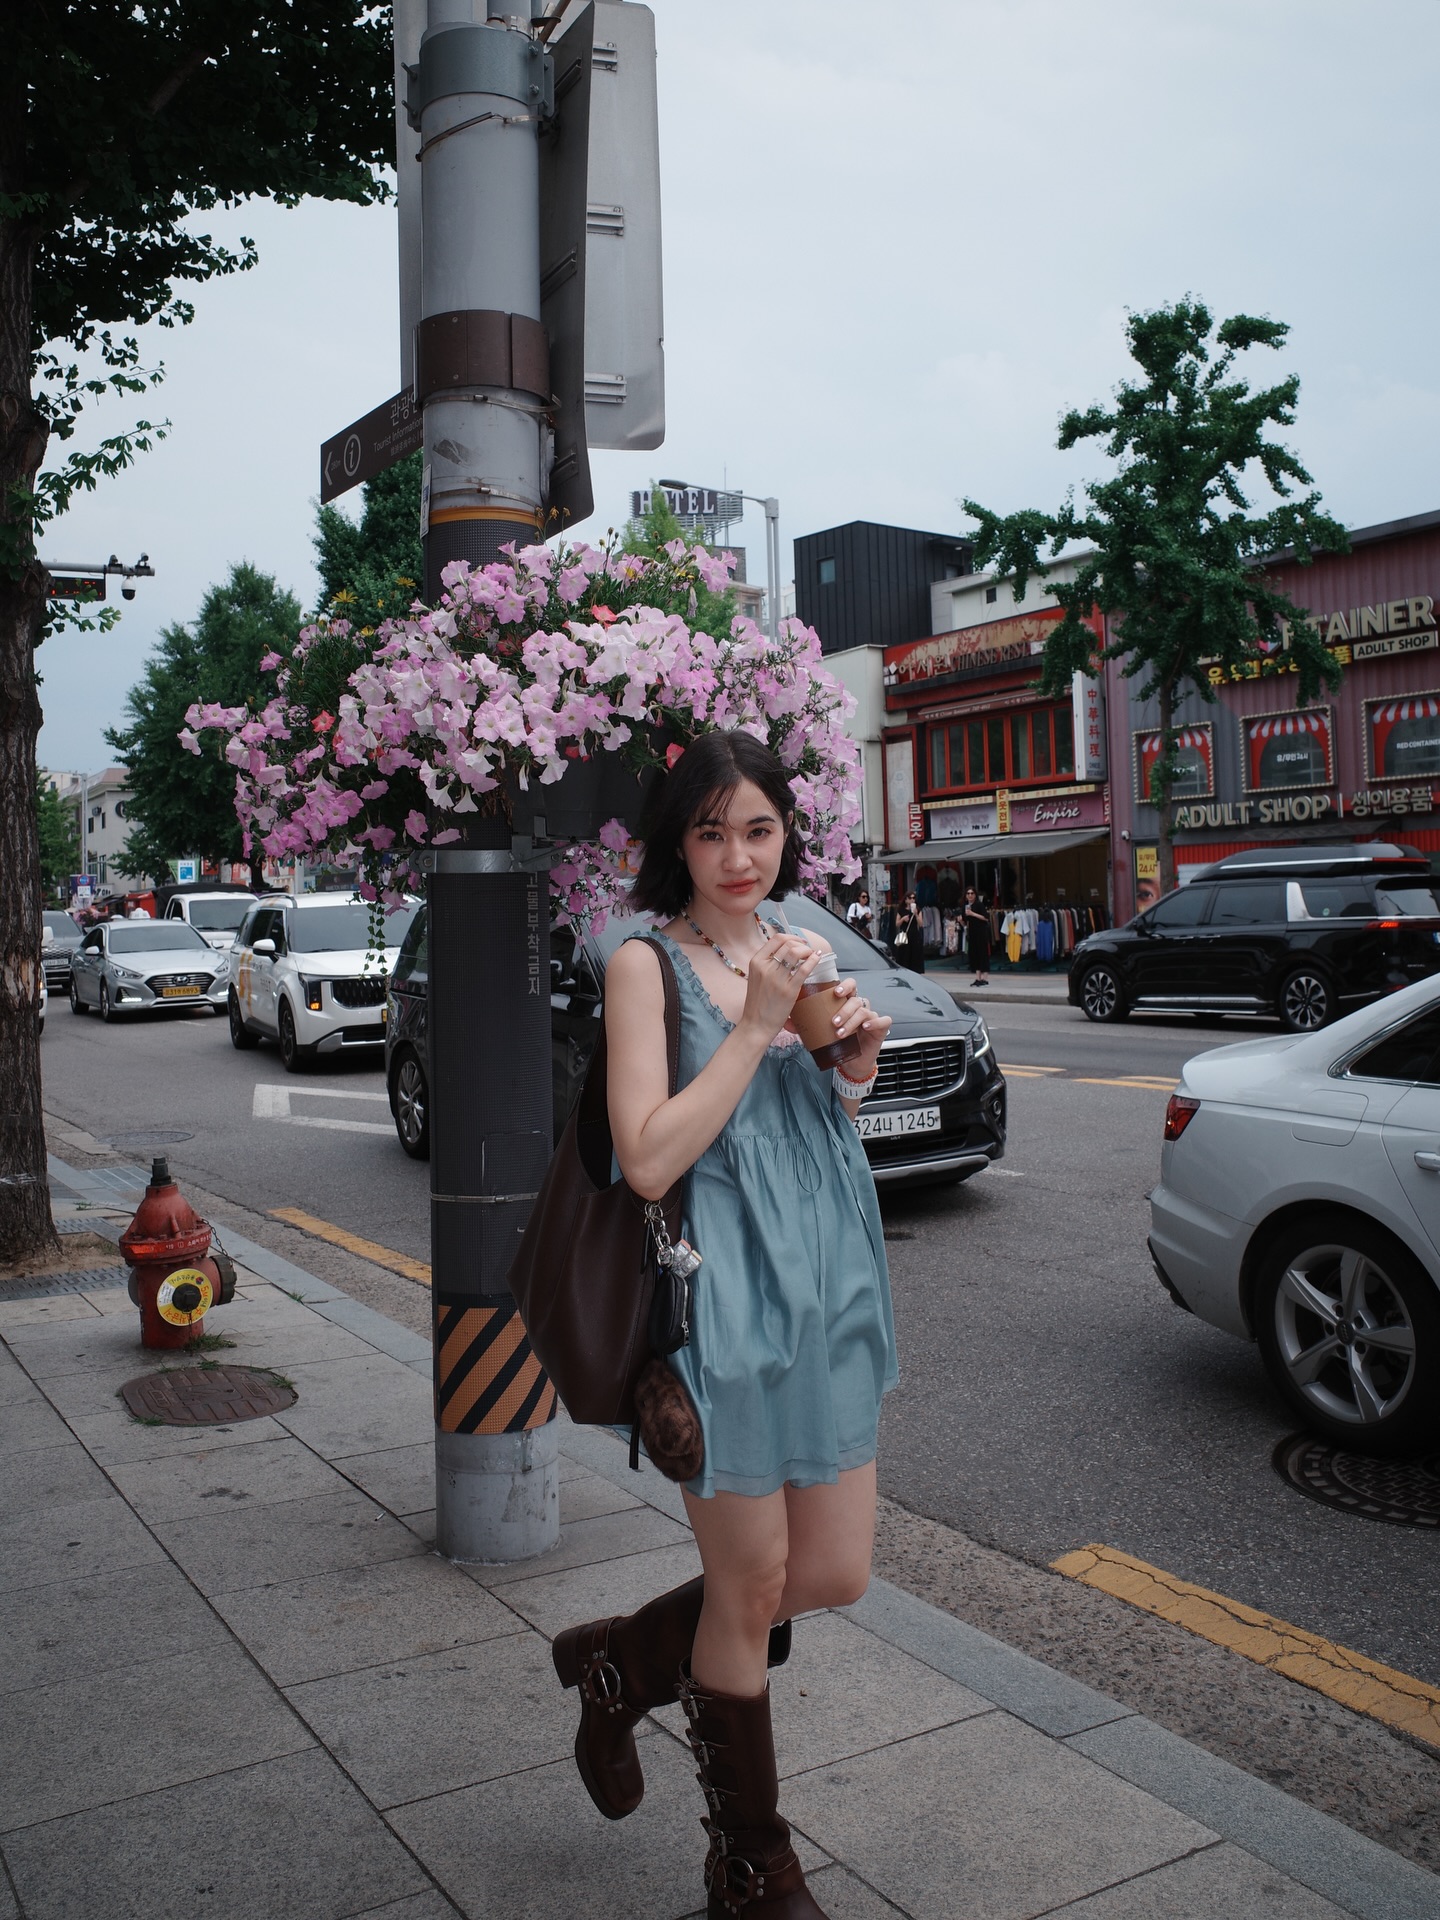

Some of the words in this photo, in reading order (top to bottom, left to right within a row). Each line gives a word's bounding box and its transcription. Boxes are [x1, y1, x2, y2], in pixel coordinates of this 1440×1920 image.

[373, 434, 392, 453] Tourist
[392, 417, 423, 442] Information
[1357, 640, 1395, 657] ADULT
[1398, 635, 1430, 650] SHOP
[951, 647, 998, 672] CHINESE
[1396, 741, 1409, 749] RED
[1033, 803, 1080, 825] Empire
[1175, 800, 1254, 828] ADULT
[1258, 794, 1331, 823] SHOP
[1351, 786, 1434, 816] 성인용품
[909, 804, 923, 838] 큰옷
[897, 1110, 935, 1131] 1245
